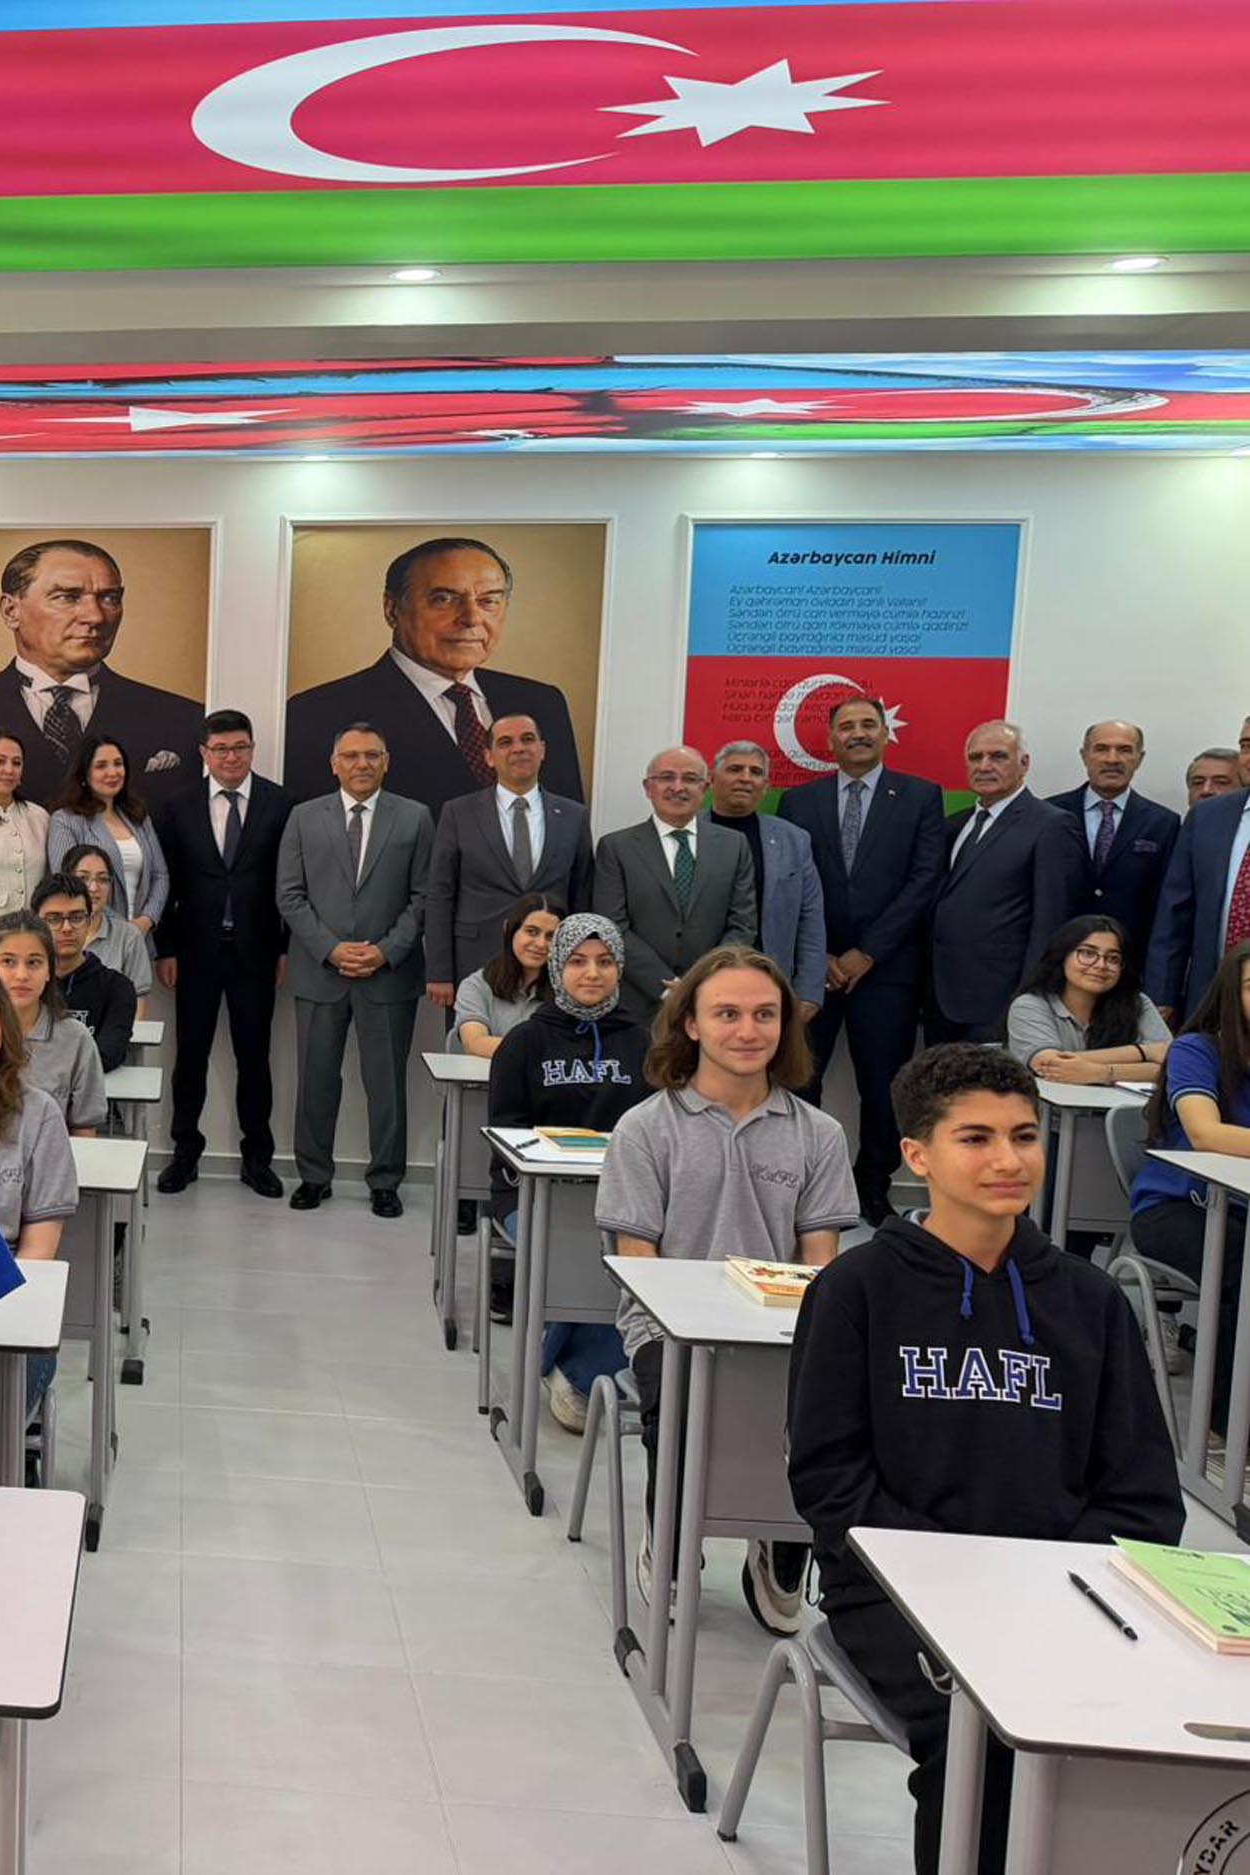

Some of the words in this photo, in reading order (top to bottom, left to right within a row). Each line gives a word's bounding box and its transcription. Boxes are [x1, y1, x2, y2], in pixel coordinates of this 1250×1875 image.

[767, 551, 877, 566] Azərbaycan
[881, 550, 937, 565] Himni
[542, 1058, 631, 1086] HAFL
[900, 1345, 1062, 1411] HAFL
